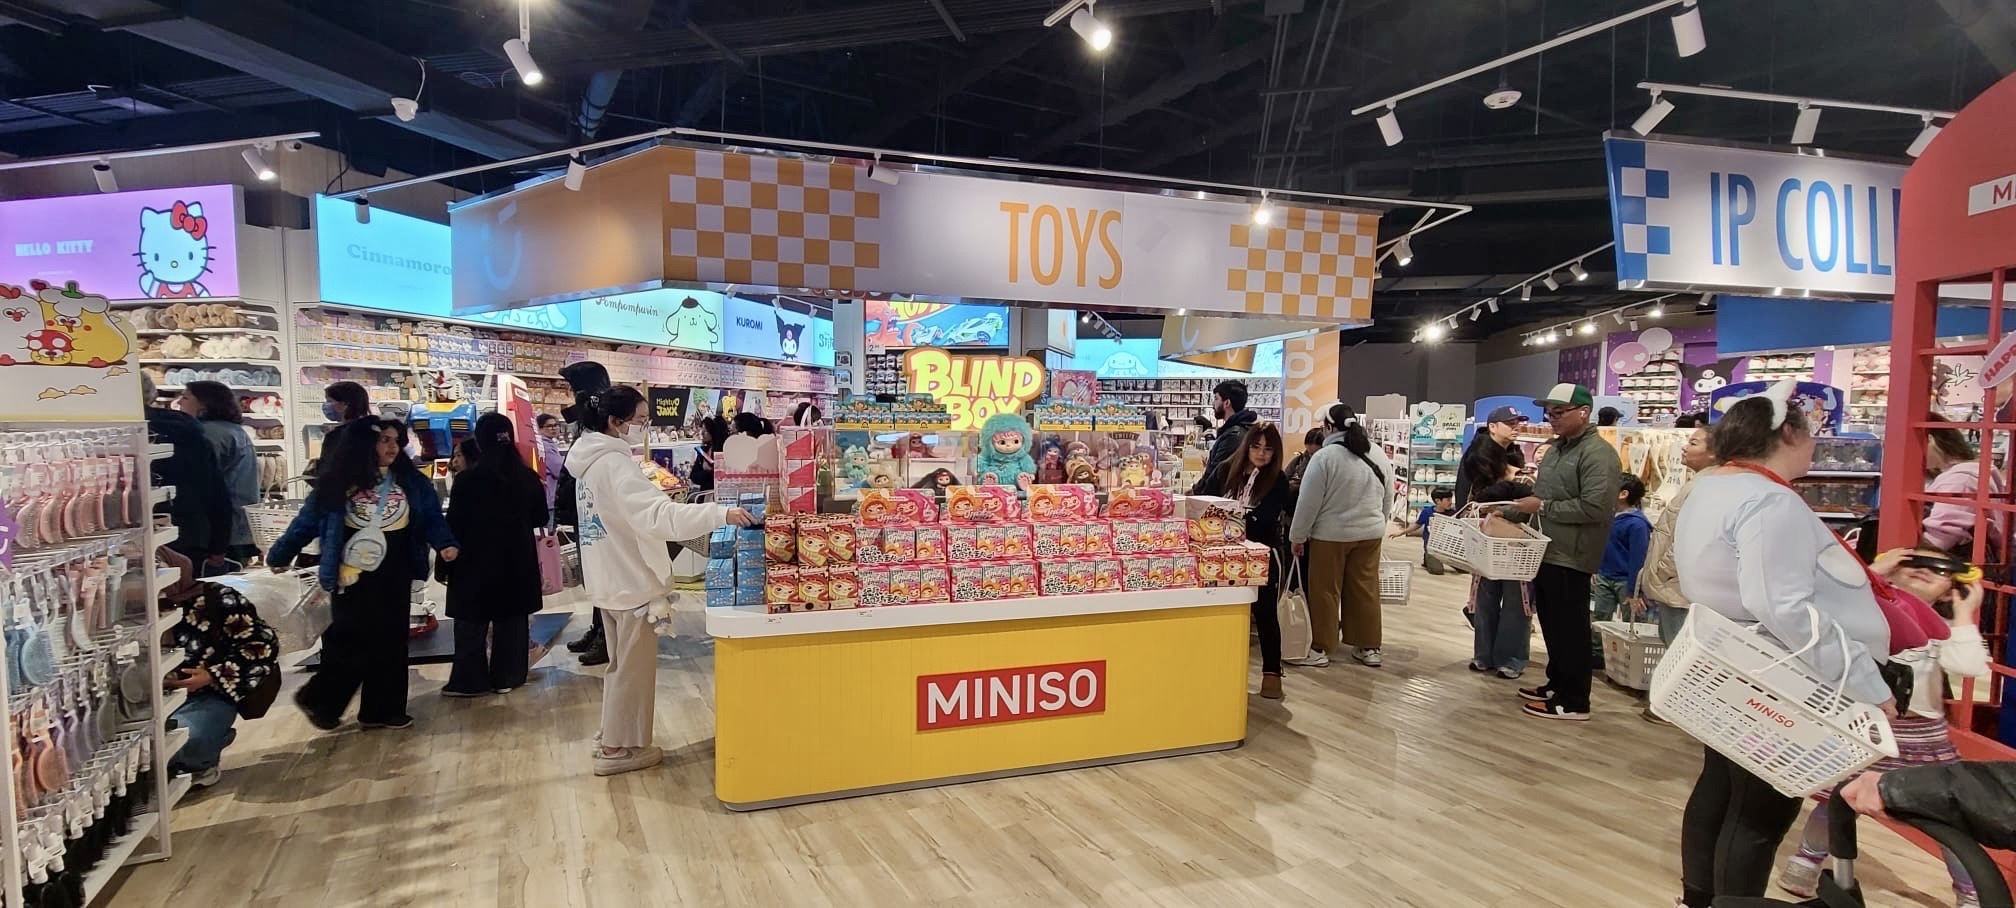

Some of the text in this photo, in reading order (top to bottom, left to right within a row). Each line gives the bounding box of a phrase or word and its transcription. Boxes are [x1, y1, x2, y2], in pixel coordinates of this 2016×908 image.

[1710, 172, 1756, 266] IP
[15, 239, 94, 257] HELLO KITTY
[1000, 201, 1123, 290] TOYS
[736, 315, 763, 330] KUROMI
[910, 350, 1042, 400] BLIND
[927, 668, 1098, 724] MINISO
[1745, 697, 1795, 728] MINISO
